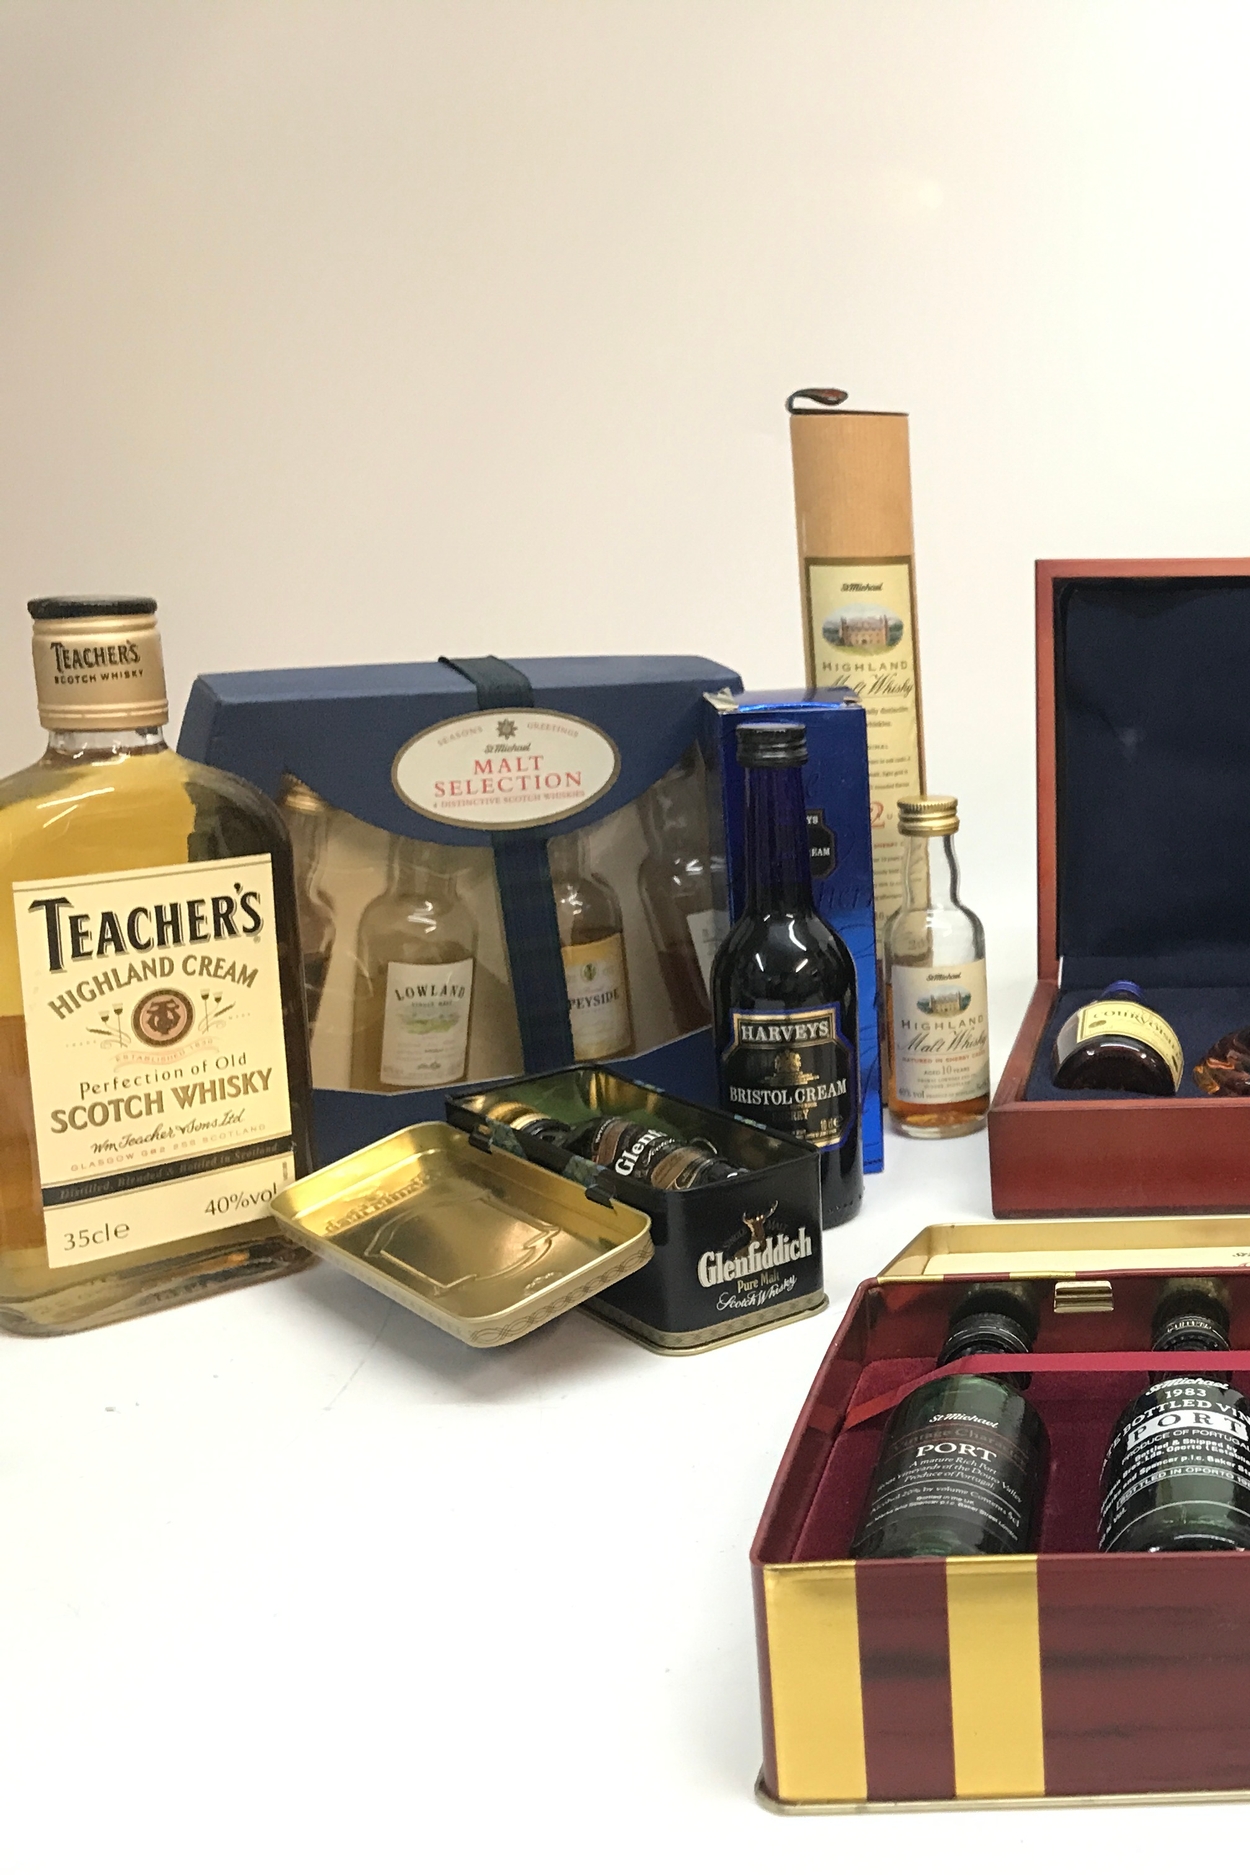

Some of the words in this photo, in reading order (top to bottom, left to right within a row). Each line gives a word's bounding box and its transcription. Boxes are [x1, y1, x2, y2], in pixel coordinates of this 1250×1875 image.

[51, 640, 140, 673] TEACHER'S
[823, 661, 908, 672] HIGHLAND
[54, 673, 96, 684] SCOTCH
[101, 669, 144, 681] WHISKY
[474, 755, 544, 775] MALT
[434, 771, 582, 798] SELECTION
[28, 882, 264, 974] TEACHER'S
[48, 956, 174, 1020] HIGHLAND
[182, 954, 258, 988] CREAM
[395, 984, 465, 1001] LOWLAND
[568, 988, 620, 1011] PEYSIDE
[741, 1021, 829, 1042] HARVEYS
[902, 1015, 984, 1030] HIGHLAND
[907, 1033, 945, 1052] Malt
[80, 1066, 183, 1100] Perfection
[191, 1060, 208, 1075] of
[216, 1052, 247, 1070] Old
[50, 1090, 164, 1134] SCOTCH
[172, 1068, 272, 1110] WHISKY
[729, 1086, 792, 1106] BRISTOL
[795, 1079, 847, 1103] CREAM
[698, 1227, 812, 1287] Glenfiddich
[717, 1291, 756, 1311] Scotch
[756, 1275, 797, 1306] Whisky
[737, 1279, 758, 1293] Pure
[761, 1271, 780, 1285] Malt
[1165, 1388, 1207, 1399] 1983
[945, 1413, 999, 1429] Michael
[1123, 1399, 1212, 1436] BOTTLED
[1133, 1412, 1243, 1444] PORT
[916, 1442, 997, 1462] PORT
[1122, 1431, 1170, 1465] PRODUCE
[1134, 1441, 1169, 1462] Bottled
[1182, 1438, 1224, 1448] Shipped
[1227, 1444, 1238, 1453] by
[956, 1457, 977, 1466] Rich
[980, 1464, 997, 1475] Port
[1139, 1456, 1178, 1476] Spencer
[1207, 1456, 1236, 1469] Baker
